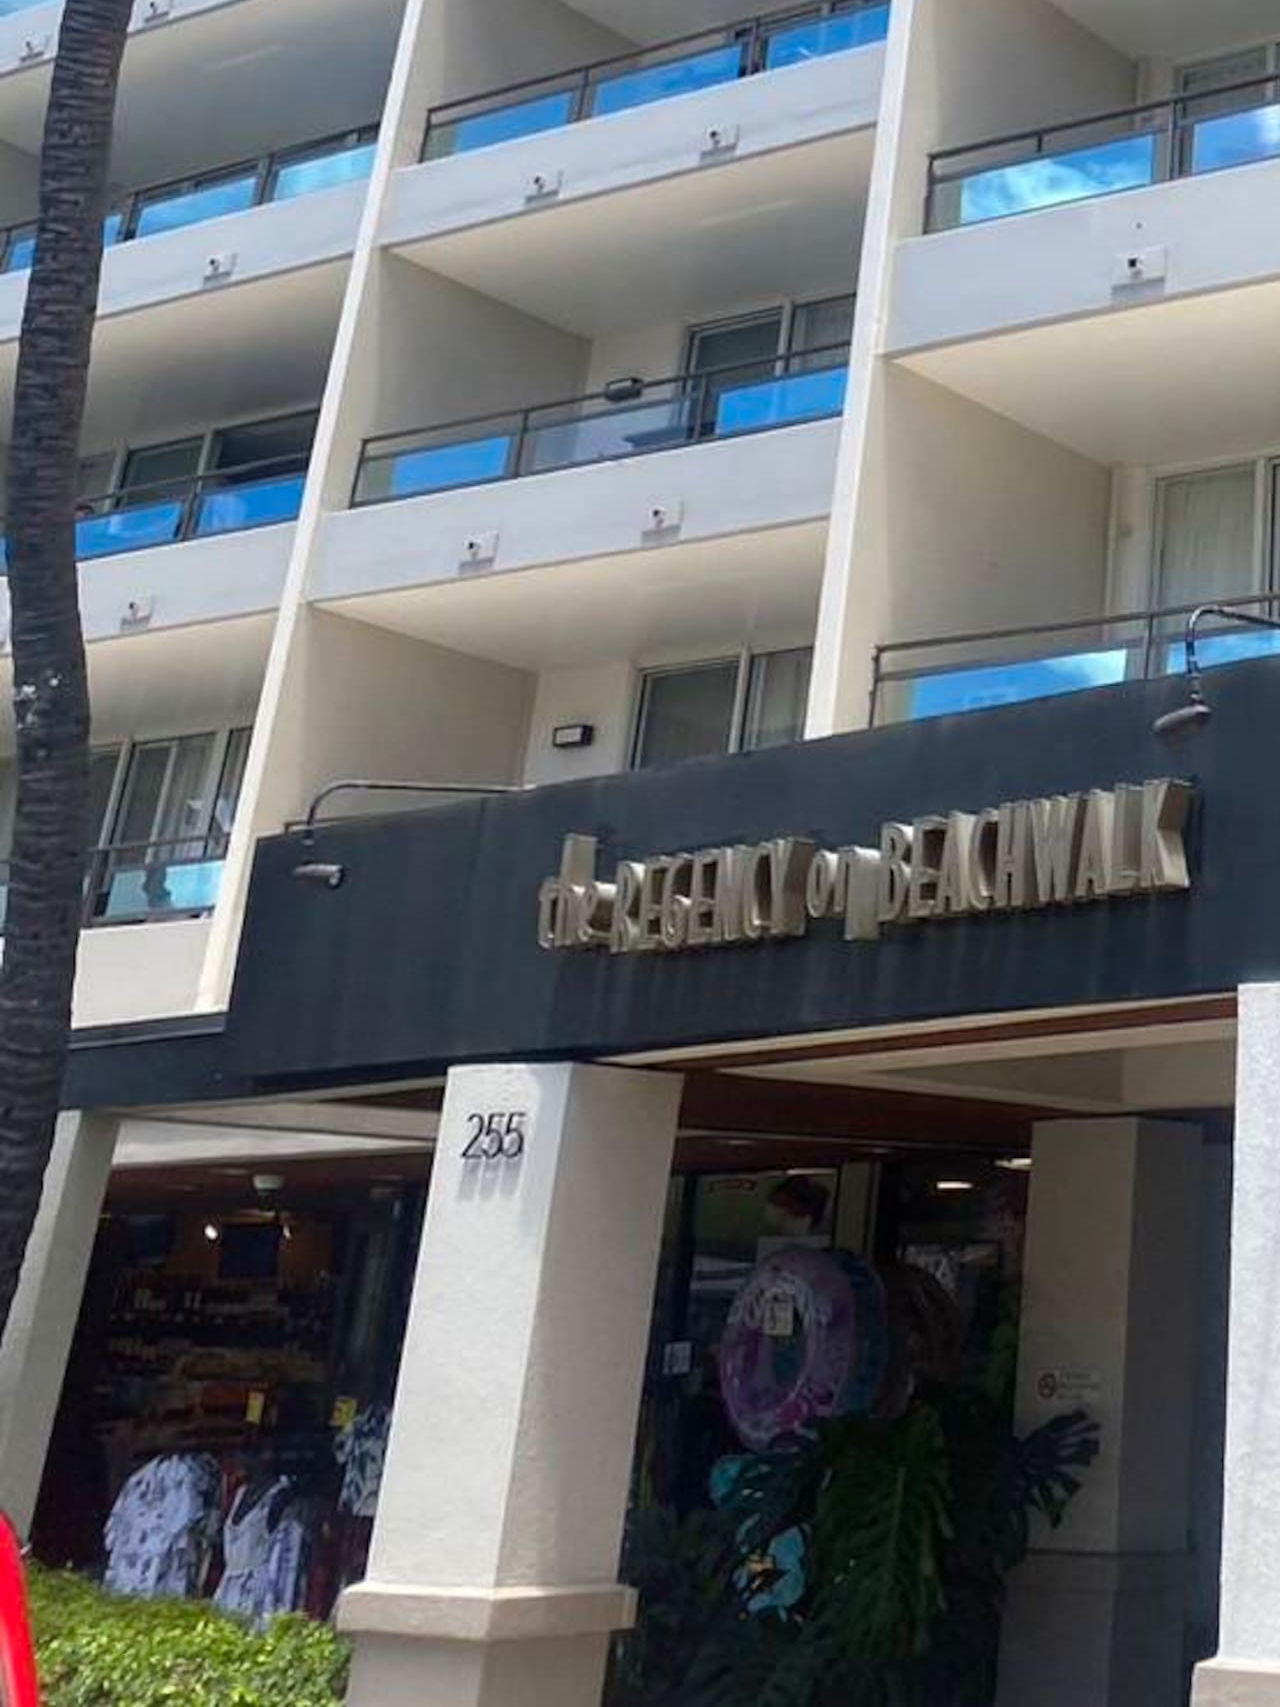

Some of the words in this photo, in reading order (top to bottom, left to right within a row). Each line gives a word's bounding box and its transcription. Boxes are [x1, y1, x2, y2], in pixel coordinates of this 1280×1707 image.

[538, 832, 619, 949] the
[609, 836, 815, 954] REGENCY
[805, 846, 883, 942] on
[878, 777, 1191, 924] BEACHWALK
[461, 1111, 526, 1159] 255
